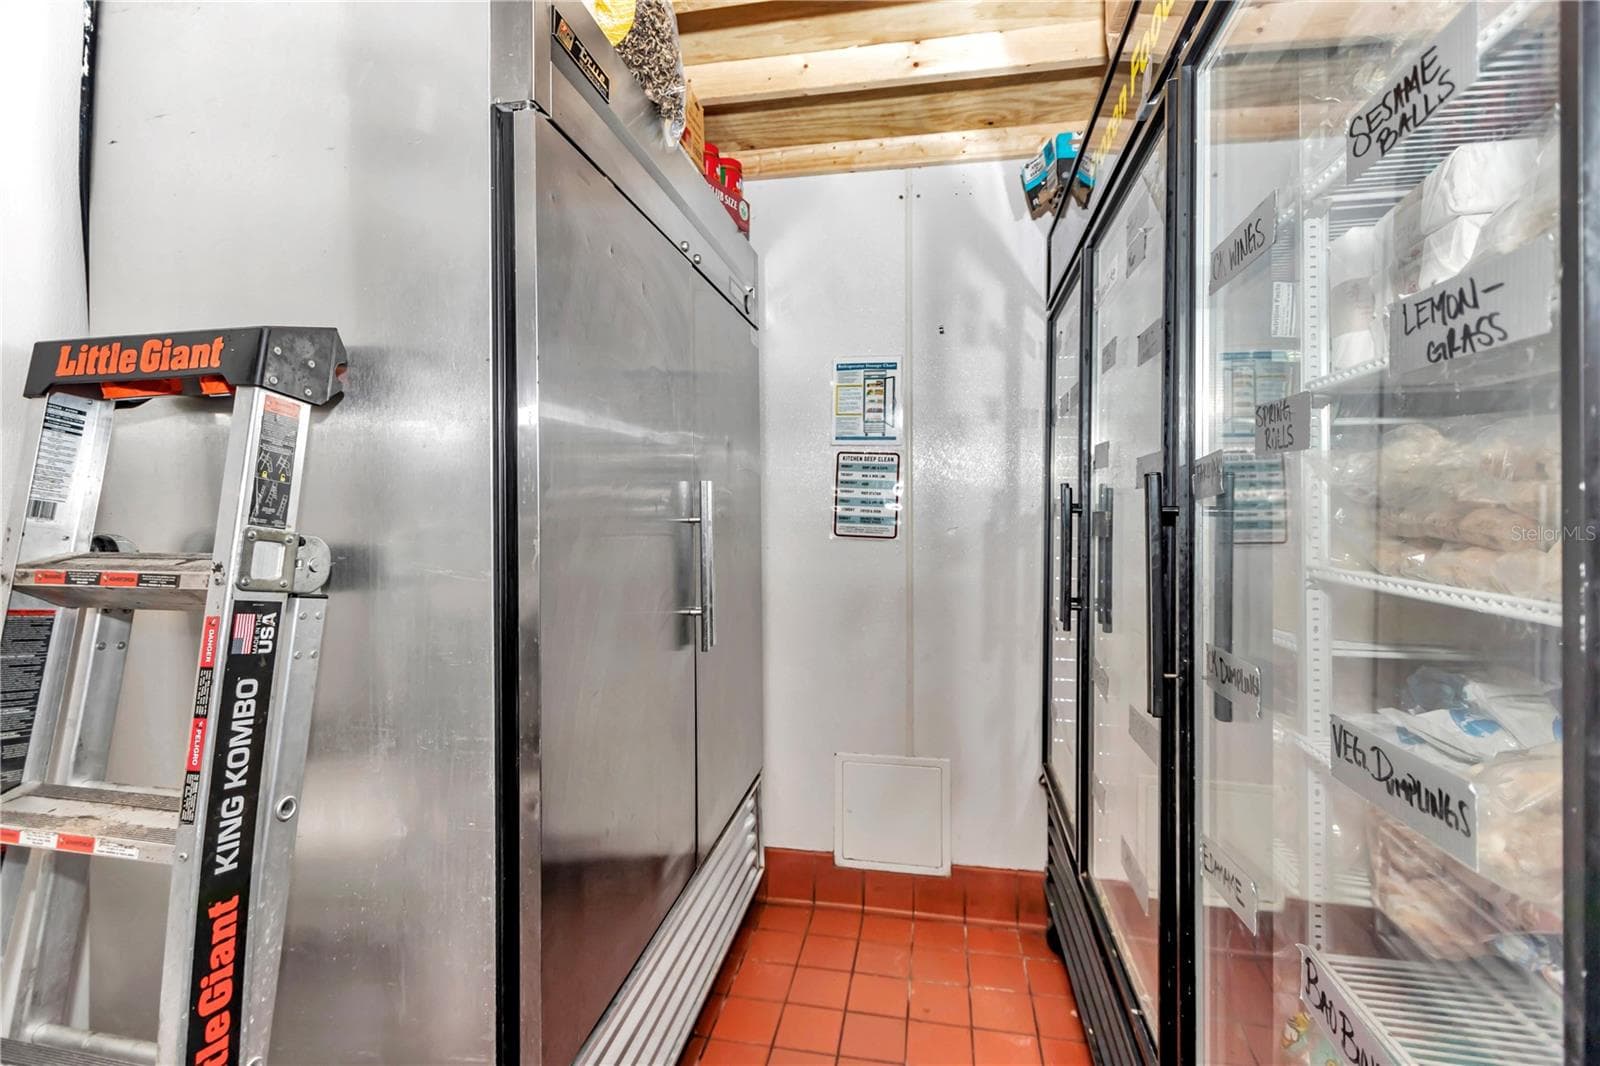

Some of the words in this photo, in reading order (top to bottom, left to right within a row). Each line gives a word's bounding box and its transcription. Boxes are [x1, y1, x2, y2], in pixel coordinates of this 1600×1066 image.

[1349, 45, 1441, 157] SESAME
[1376, 69, 1455, 157] BALLS
[724, 194, 738, 211] SIZE
[1228, 218, 1265, 271] WINGS
[55, 341, 138, 377] Little
[139, 336, 225, 372] Giant
[1426, 311, 1508, 363] GRASS
[1255, 400, 1291, 427] SPRING
[205, 629, 215, 663] DANGER
[257, 611, 277, 654] USA
[192, 729, 202, 766] PELIGRO
[224, 678, 258, 789] KOMBO
[214, 796, 245, 876] KING
[198, 895, 239, 1017] Giant
